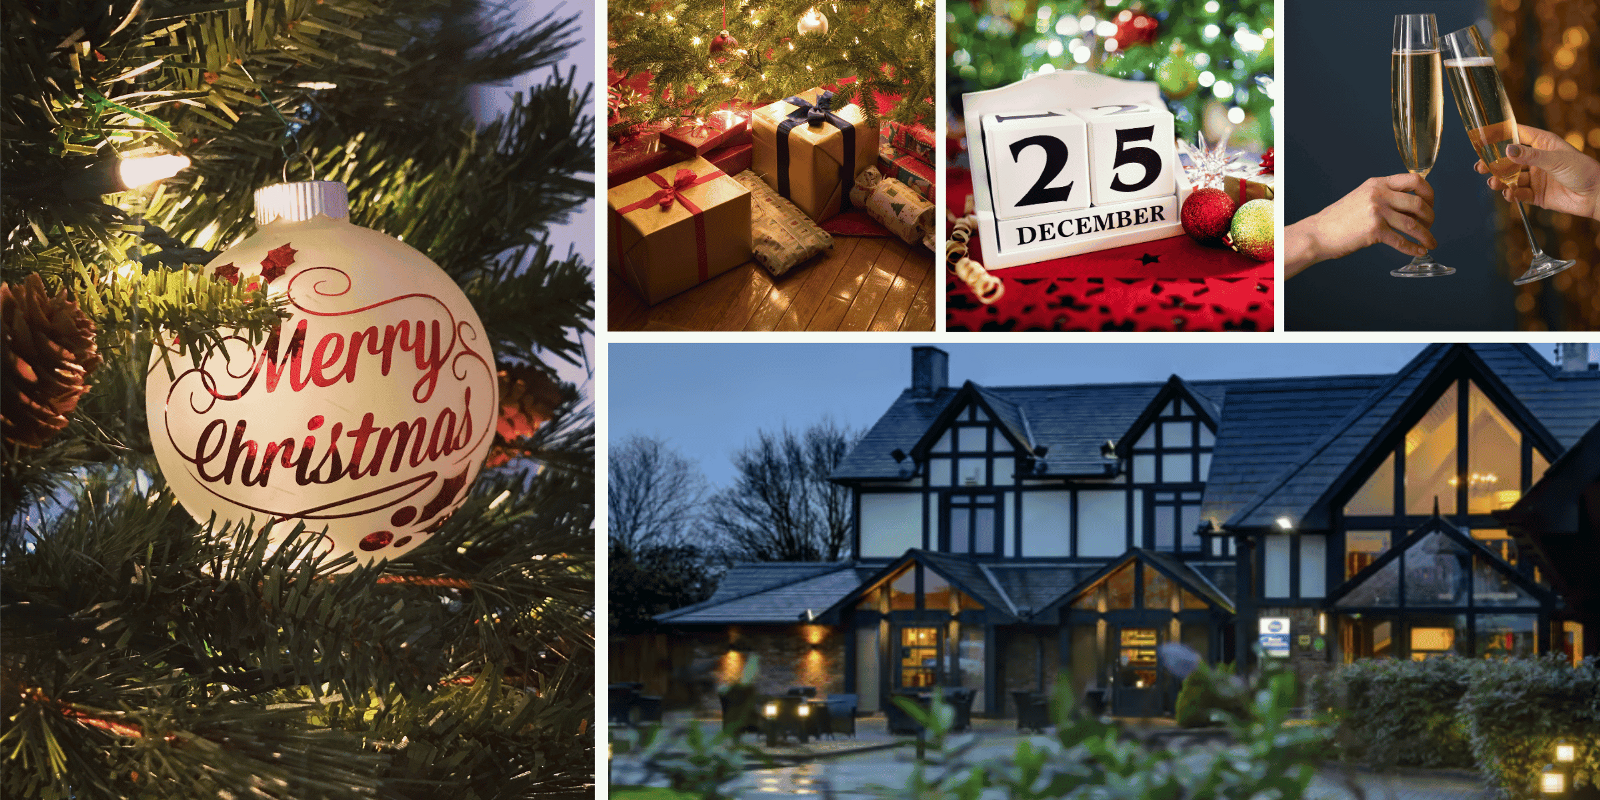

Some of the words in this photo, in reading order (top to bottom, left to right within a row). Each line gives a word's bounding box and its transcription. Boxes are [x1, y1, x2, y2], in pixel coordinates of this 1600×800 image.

[1016, 205, 1166, 246] DECEMBER
[243, 318, 443, 404] Merry
[196, 386, 473, 488] Christmas
